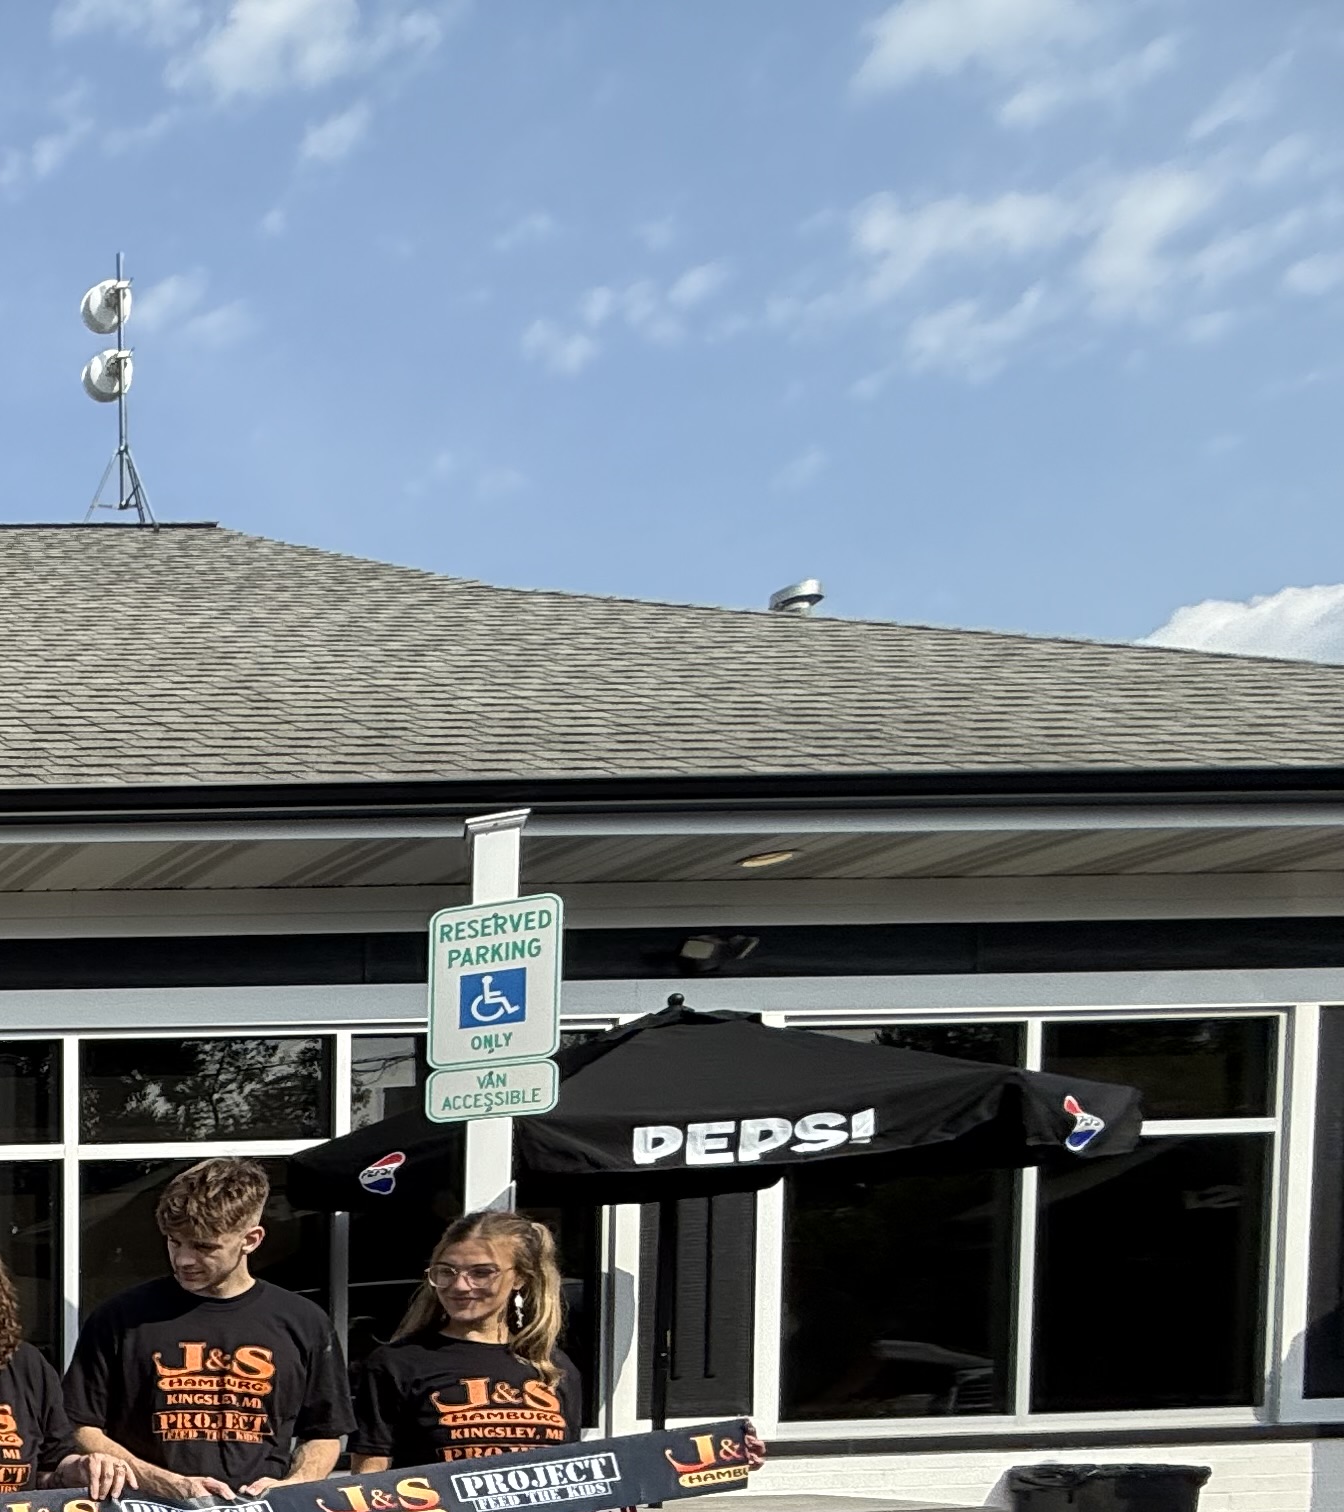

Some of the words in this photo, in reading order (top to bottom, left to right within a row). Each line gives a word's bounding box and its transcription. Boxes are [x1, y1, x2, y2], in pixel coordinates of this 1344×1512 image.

[439, 909, 553, 943] RESERVED
[447, 938, 542, 969] PARKING
[471, 1032, 513, 1051] ONLY
[477, 1073, 507, 1090] VAN
[441, 1087, 542, 1112] ACCESSIBLE
[632, 1107, 876, 1166] PEPSI
[152, 1341, 276, 1379] J&S
[430, 1377, 560, 1413] J&S
[159, 1413, 267, 1431] PROJECT
[450, 1427, 541, 1440] KINGSLEY,
[545, 1429, 564, 1441] MI
[3, 1449, 21, 1460] MI
[665, 1434, 743, 1473] J&
[461, 1458, 606, 1498] PROJECT
[477, 1496, 520, 1510] FEED
[526, 1488, 561, 1503] THE
[567, 1482, 607, 1498] KIDS
